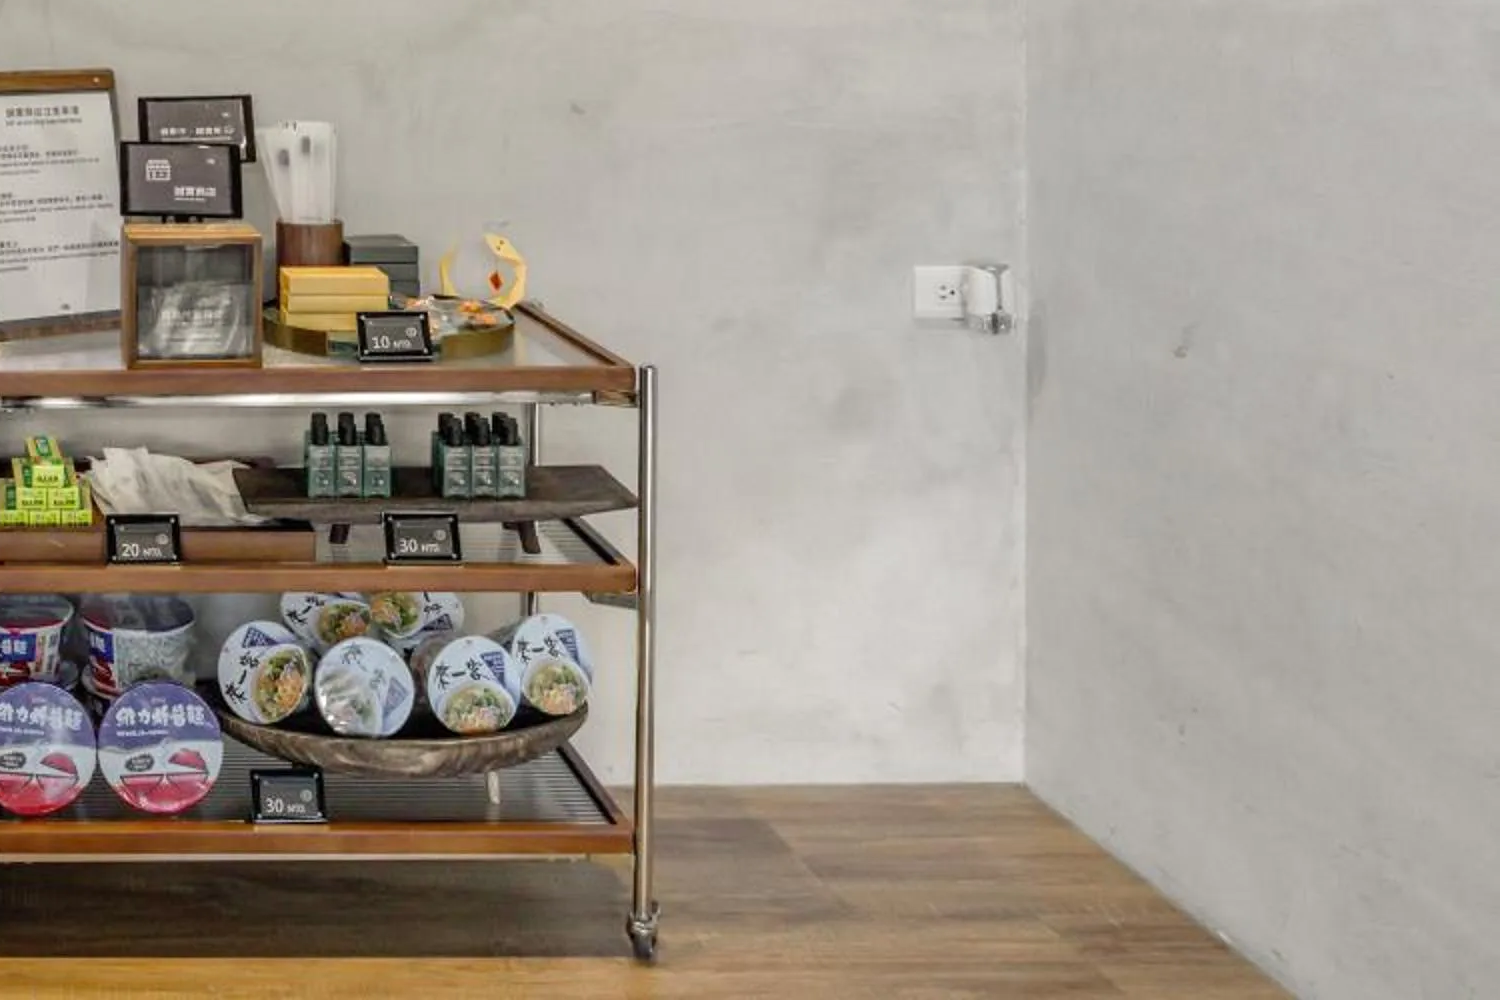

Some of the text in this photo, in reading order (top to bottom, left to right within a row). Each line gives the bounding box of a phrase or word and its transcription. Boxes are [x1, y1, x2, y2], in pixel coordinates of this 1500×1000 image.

[372, 335, 390, 349] 10
[122, 543, 139, 557] 20
[400, 538, 417, 552] 30
[265, 798, 284, 813] 30
